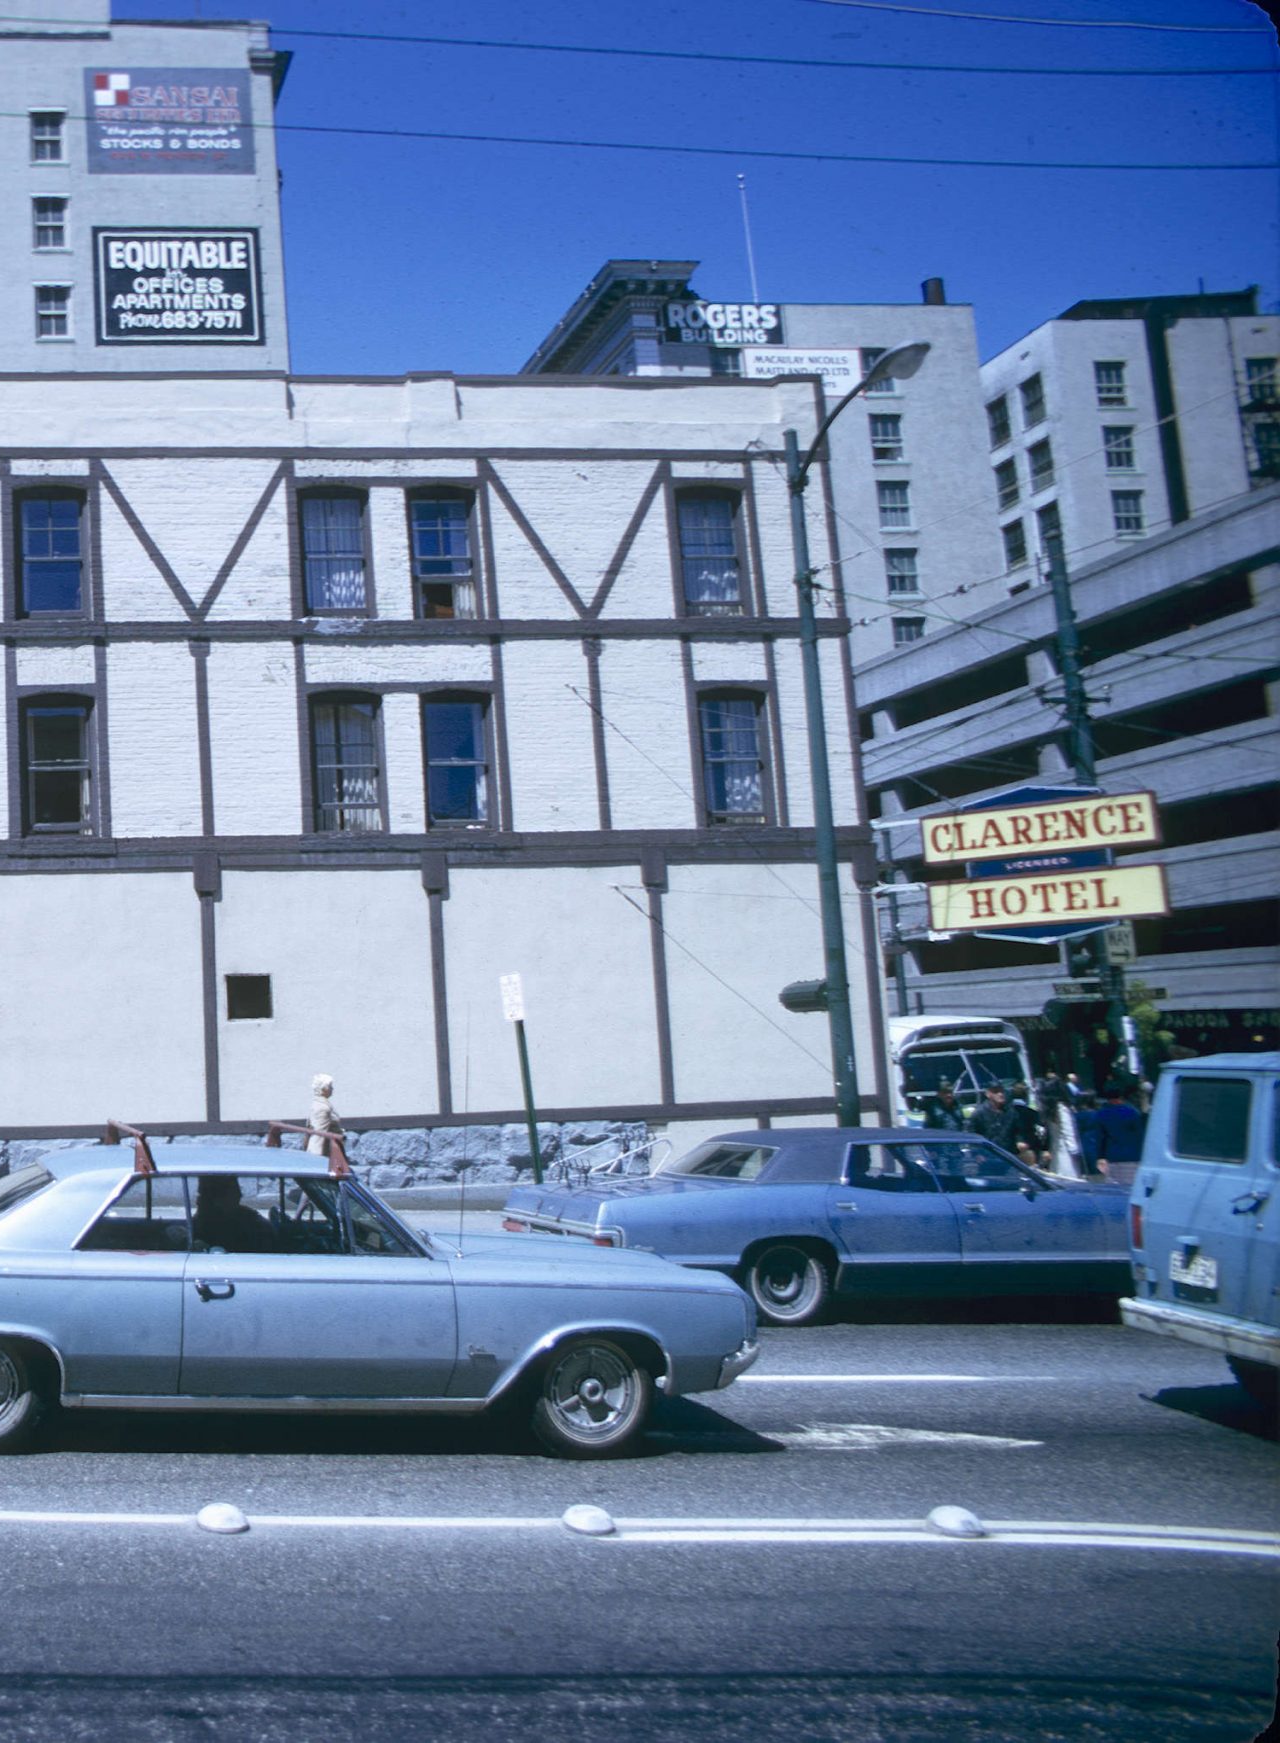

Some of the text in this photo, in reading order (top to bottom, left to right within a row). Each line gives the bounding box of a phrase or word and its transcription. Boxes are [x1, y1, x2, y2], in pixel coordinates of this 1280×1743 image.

[130, 86, 239, 107] SANSAI
[99, 138, 242, 149] STOCKS & BONDS
[108, 241, 247, 272] EQUITABLE
[133, 277, 224, 293] OFFICES
[112, 293, 247, 310] APARTMENTS
[161, 311, 242, 329] 683-7571
[667, 304, 778, 329] ROGERS
[681, 329, 768, 343] BUILDING
[808, 356, 848, 364] NICOLLS
[931, 802, 1145, 854] CLARENCE
[1005, 857, 1071, 871] LICENSED
[968, 878, 1119, 919] HOTEL
